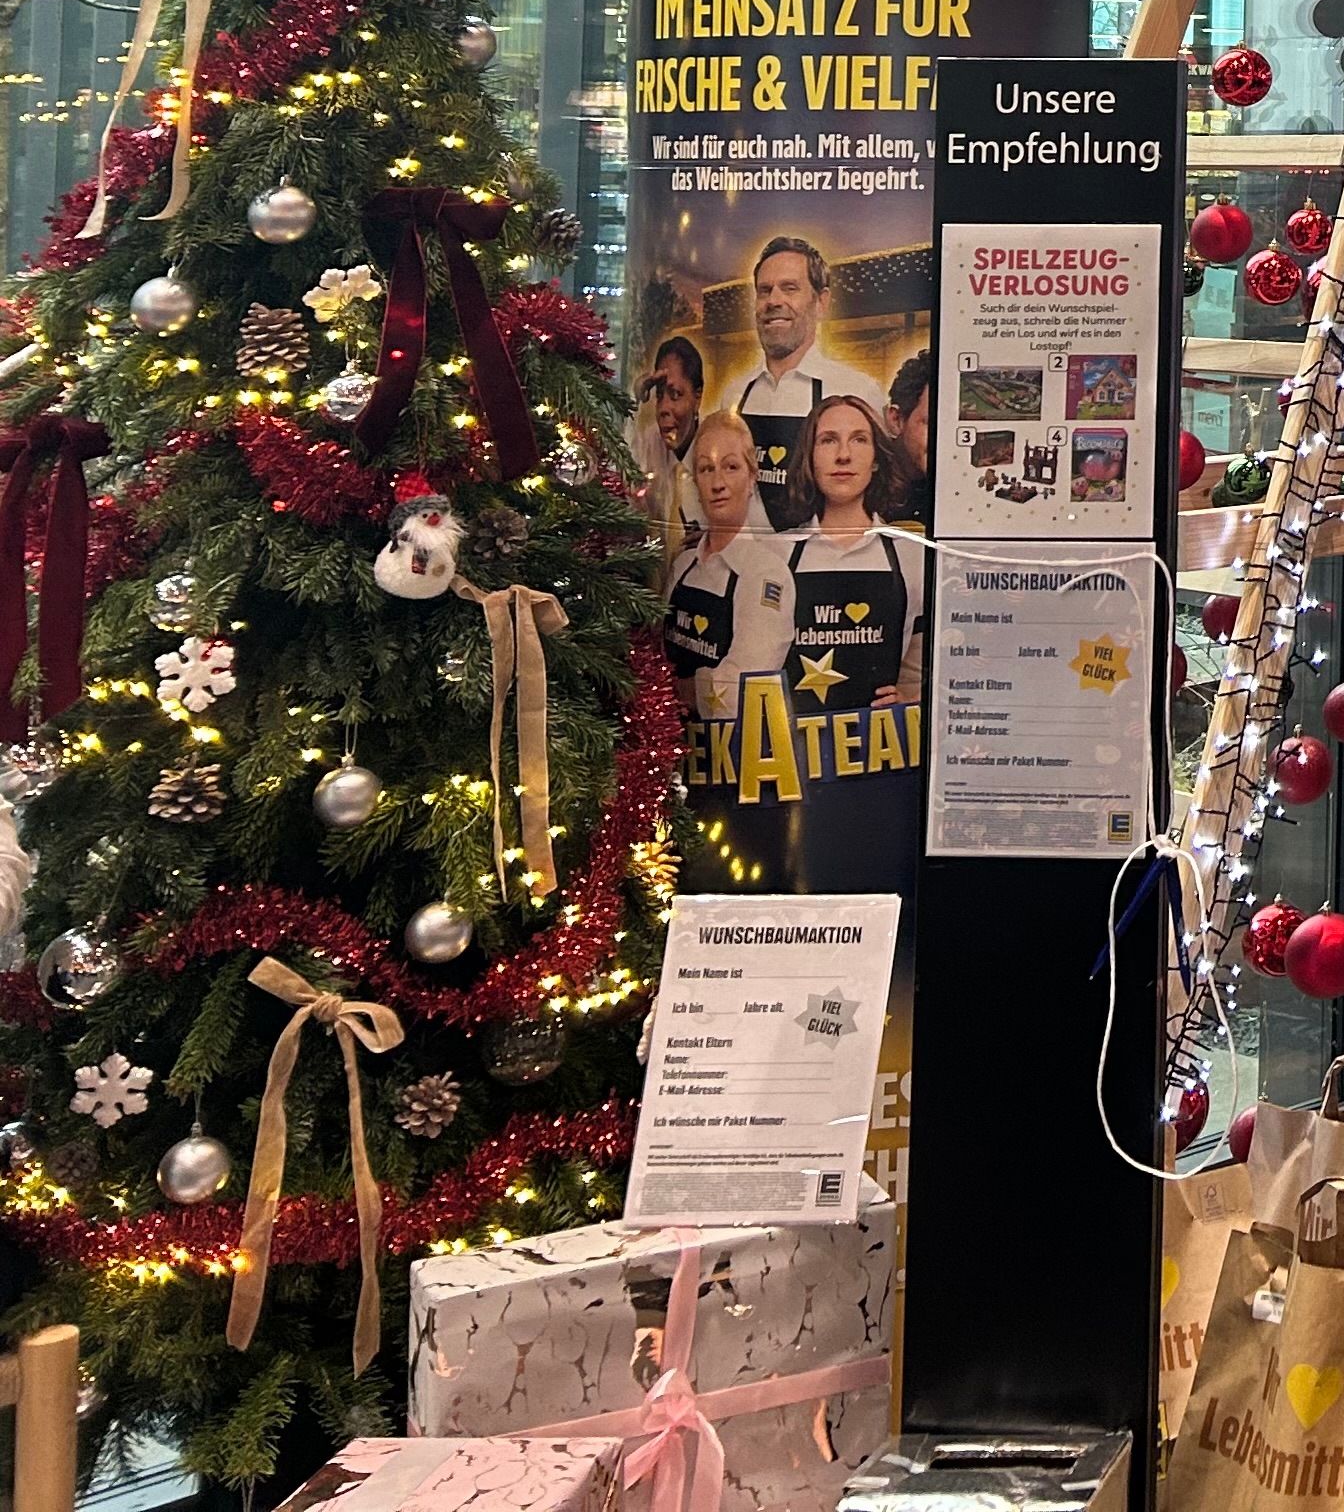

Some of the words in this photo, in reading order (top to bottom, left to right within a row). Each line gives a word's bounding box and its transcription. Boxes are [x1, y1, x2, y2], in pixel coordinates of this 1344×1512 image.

[636, 55, 743, 114] FRISCHE
[752, 54, 788, 112] &
[801, 54, 937, 111] VIELF
[995, 83, 1116, 115] Unsere
[652, 134, 671, 159] Wir
[672, 133, 699, 160] sind
[701, 133, 726, 159] für
[727, 133, 768, 159] euch
[771, 133, 812, 159] nah.
[817, 132, 851, 159] Mit
[855, 133, 921, 162] allem,
[947, 131, 1161, 172] Empfehlung
[671, 166, 693, 191] das
[695, 165, 832, 191] Weihnachtsherz
[837, 166, 926, 196] begehrt.
[973, 247, 1130, 272] SPIELZEUG-
[968, 273, 1130, 297] VERLOSUNG
[980, 303, 1006, 314] Such
[1007, 303, 1022, 313] dir
[1023, 303, 1046, 313] dein
[1048, 303, 1119, 315] Wunschspiel-
[972, 317, 998, 328] zeug
[1000, 317, 1021, 327] aus,
[1023, 316, 1061, 326] schreib
[1063, 316, 1080, 326] die
[1081, 316, 1127, 326] Nummer
[981, 329, 999, 339] auf
[1000, 329, 1016, 339] ein
[1017, 329, 1036, 338] Los
[1037, 329, 1058, 339] und
[1059, 329, 1079, 338] wirf
[1080, 330, 1092, 339] es
[1093, 329, 1102, 339] in
[1103, 329, 1122, 339] den
[965, 357, 972, 369] 1
[1053, 356, 1063, 368] 2
[961, 431, 971, 442] 3
[1051, 431, 1062, 442] 4
[965, 571, 1126, 592] WUNSCHBAUMAKTION
[814, 604, 842, 625] Wir
[951, 612, 973, 623] Mein
[974, 612, 1000, 624] Name
[1001, 612, 1013, 624] ist
[950, 645, 964, 657] Ich
[966, 645, 980, 657] bin
[1018, 646, 1042, 658] Jahre
[1093, 645, 1114, 661] VIEL
[1082, 663, 1117, 682] GLÜCK
[948, 679, 985, 690] Kontakt
[986, 679, 1013, 691] Eltern
[946, 755, 959, 765] Ich
[1012, 756, 1034, 767] Paket
[699, 926, 863, 945] WUNSCHBAUMAKTION
[678, 968, 701, 979] Mein
[702, 967, 728, 979] Name
[730, 967, 743, 978] ist
[672, 1002, 687, 1014] Ich
[689, 1002, 704, 1013] bin
[743, 1001, 768, 1013] Jahre
[821, 999, 842, 1015] VIEL
[807, 1018, 842, 1037] GLÜCK
[667, 1037, 703, 1049] Kontakt
[653, 1116, 667, 1127] Ich
[723, 1116, 748, 1127] Paket
